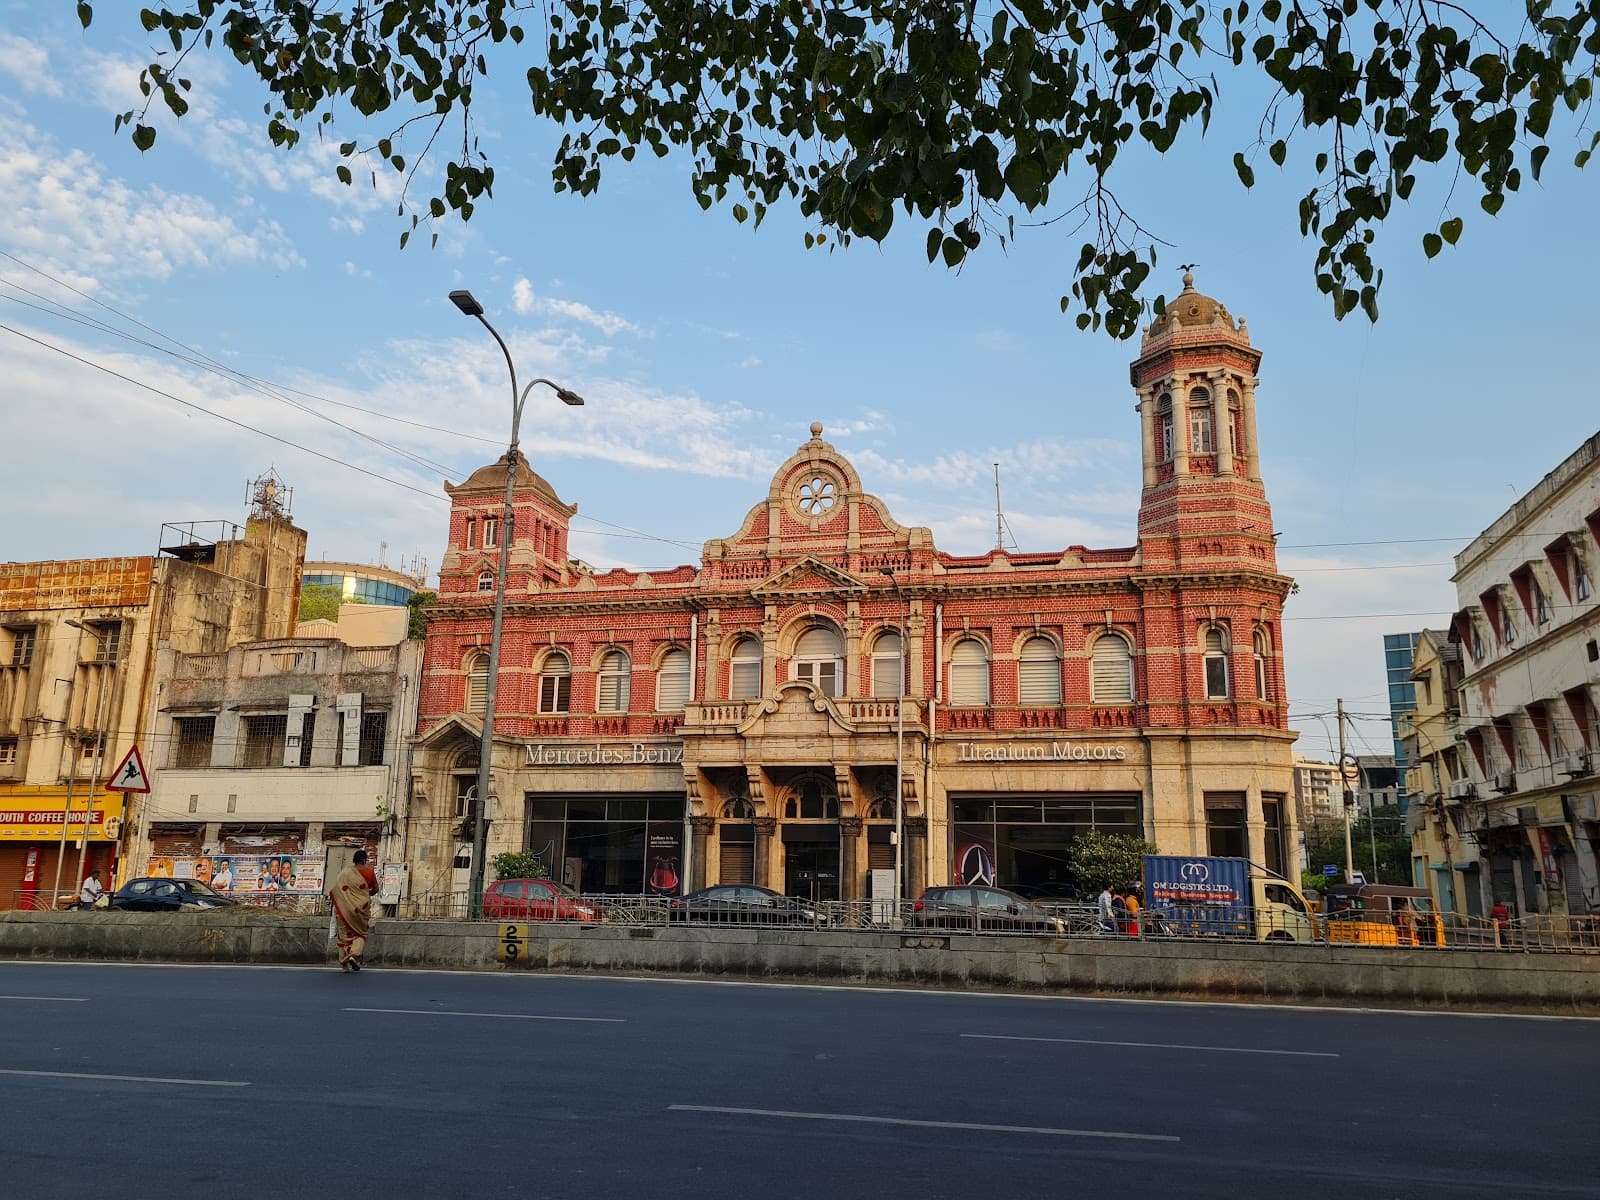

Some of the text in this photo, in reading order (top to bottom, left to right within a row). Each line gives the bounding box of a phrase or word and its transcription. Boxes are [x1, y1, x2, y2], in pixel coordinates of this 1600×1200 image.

[524, 743, 684, 765] Mercedes-Benz
[957, 741, 1127, 760] Titanium Motors
[27, 812, 65, 823] COFFEE
[1153, 881, 1233, 892] OM LOGISTICS LTD.
[506, 925, 518, 940] 2
[505, 943, 518, 961] 9
